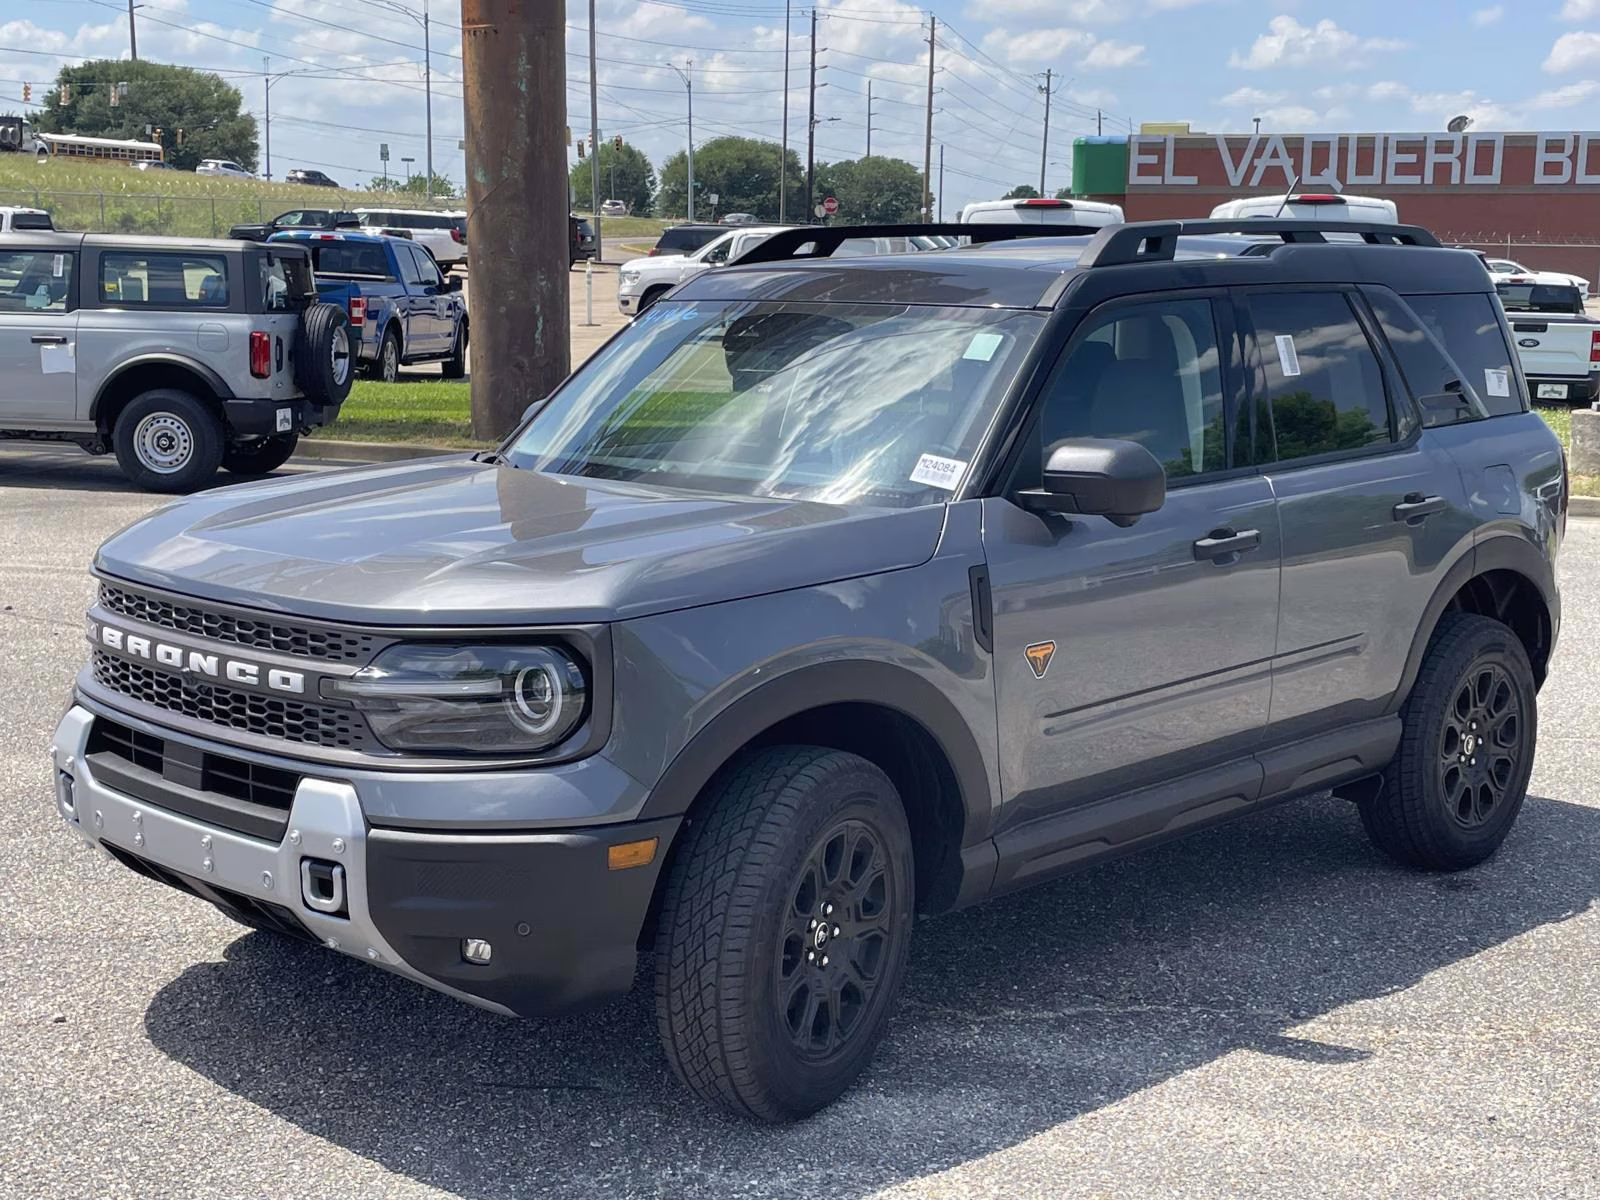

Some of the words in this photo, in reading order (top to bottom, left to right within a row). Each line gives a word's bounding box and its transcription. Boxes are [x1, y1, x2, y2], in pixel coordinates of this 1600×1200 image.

[1129, 134, 1198, 185] EL
[1216, 132, 1504, 193] VAQUERO
[921, 457, 957, 473] M24084
[102, 626, 304, 693] BRONCO
